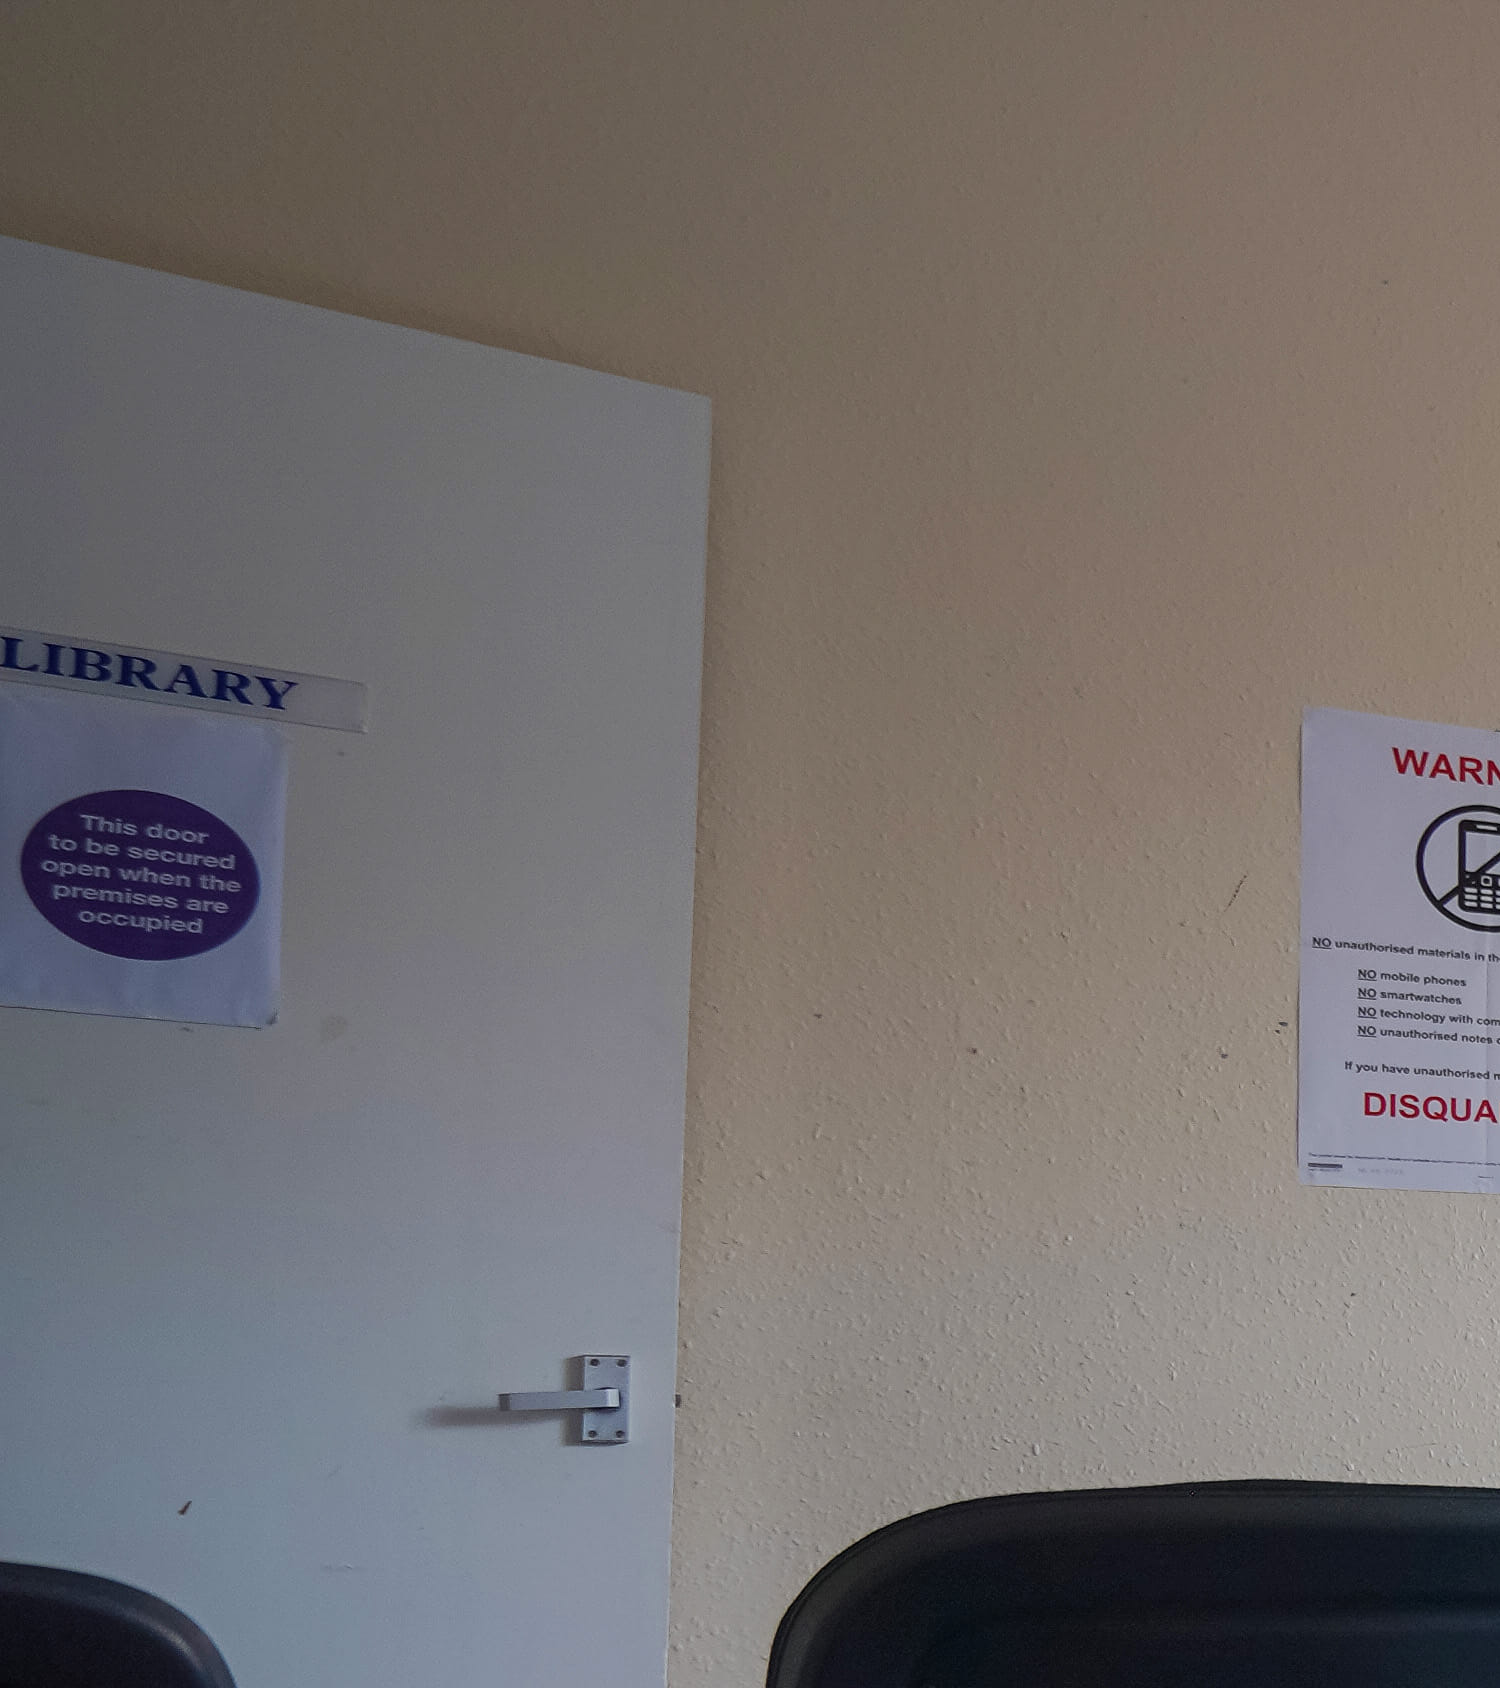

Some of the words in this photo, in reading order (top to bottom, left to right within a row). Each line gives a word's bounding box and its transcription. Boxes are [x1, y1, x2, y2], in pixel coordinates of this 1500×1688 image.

[0, 636, 299, 711] LIBRARY
[80, 814, 138, 836] This
[146, 824, 210, 844] door
[48, 834, 77, 851] to
[85, 838, 120, 856] be
[127, 846, 236, 870] secured
[41, 860, 111, 879] open
[119, 867, 192, 888] when
[200, 874, 242, 893] the
[53, 884, 178, 909] premises
[186, 899, 229, 914] are
[78, 910, 203, 934] occupied
[1312, 937, 1332, 948] NO
[1335, 940, 1414, 955] unauthorised
[1418, 949, 1471, 960] materials
[1474, 952, 1485, 962] in
[1358, 969, 1377, 981] NO
[1380, 971, 1420, 983] mobile
[1423, 975, 1467, 987] phones
[1358, 988, 1377, 1000] NO
[1380, 991, 1462, 1005] smartwatches
[1358, 1007, 1377, 1018] NO
[1380, 1009, 1445, 1024] technology
[1449, 1014, 1473, 1025] with
[1357, 1026, 1377, 1037] NO
[1380, 1030, 1458, 1042] unauthorised
[1461, 1034, 1493, 1045] notes
[1344, 1061, 1353, 1070] If
[1356, 1063, 1378, 1073] you
[1381, 1064, 1410, 1074] have
[1413, 1067, 1490, 1080] unauthorised
